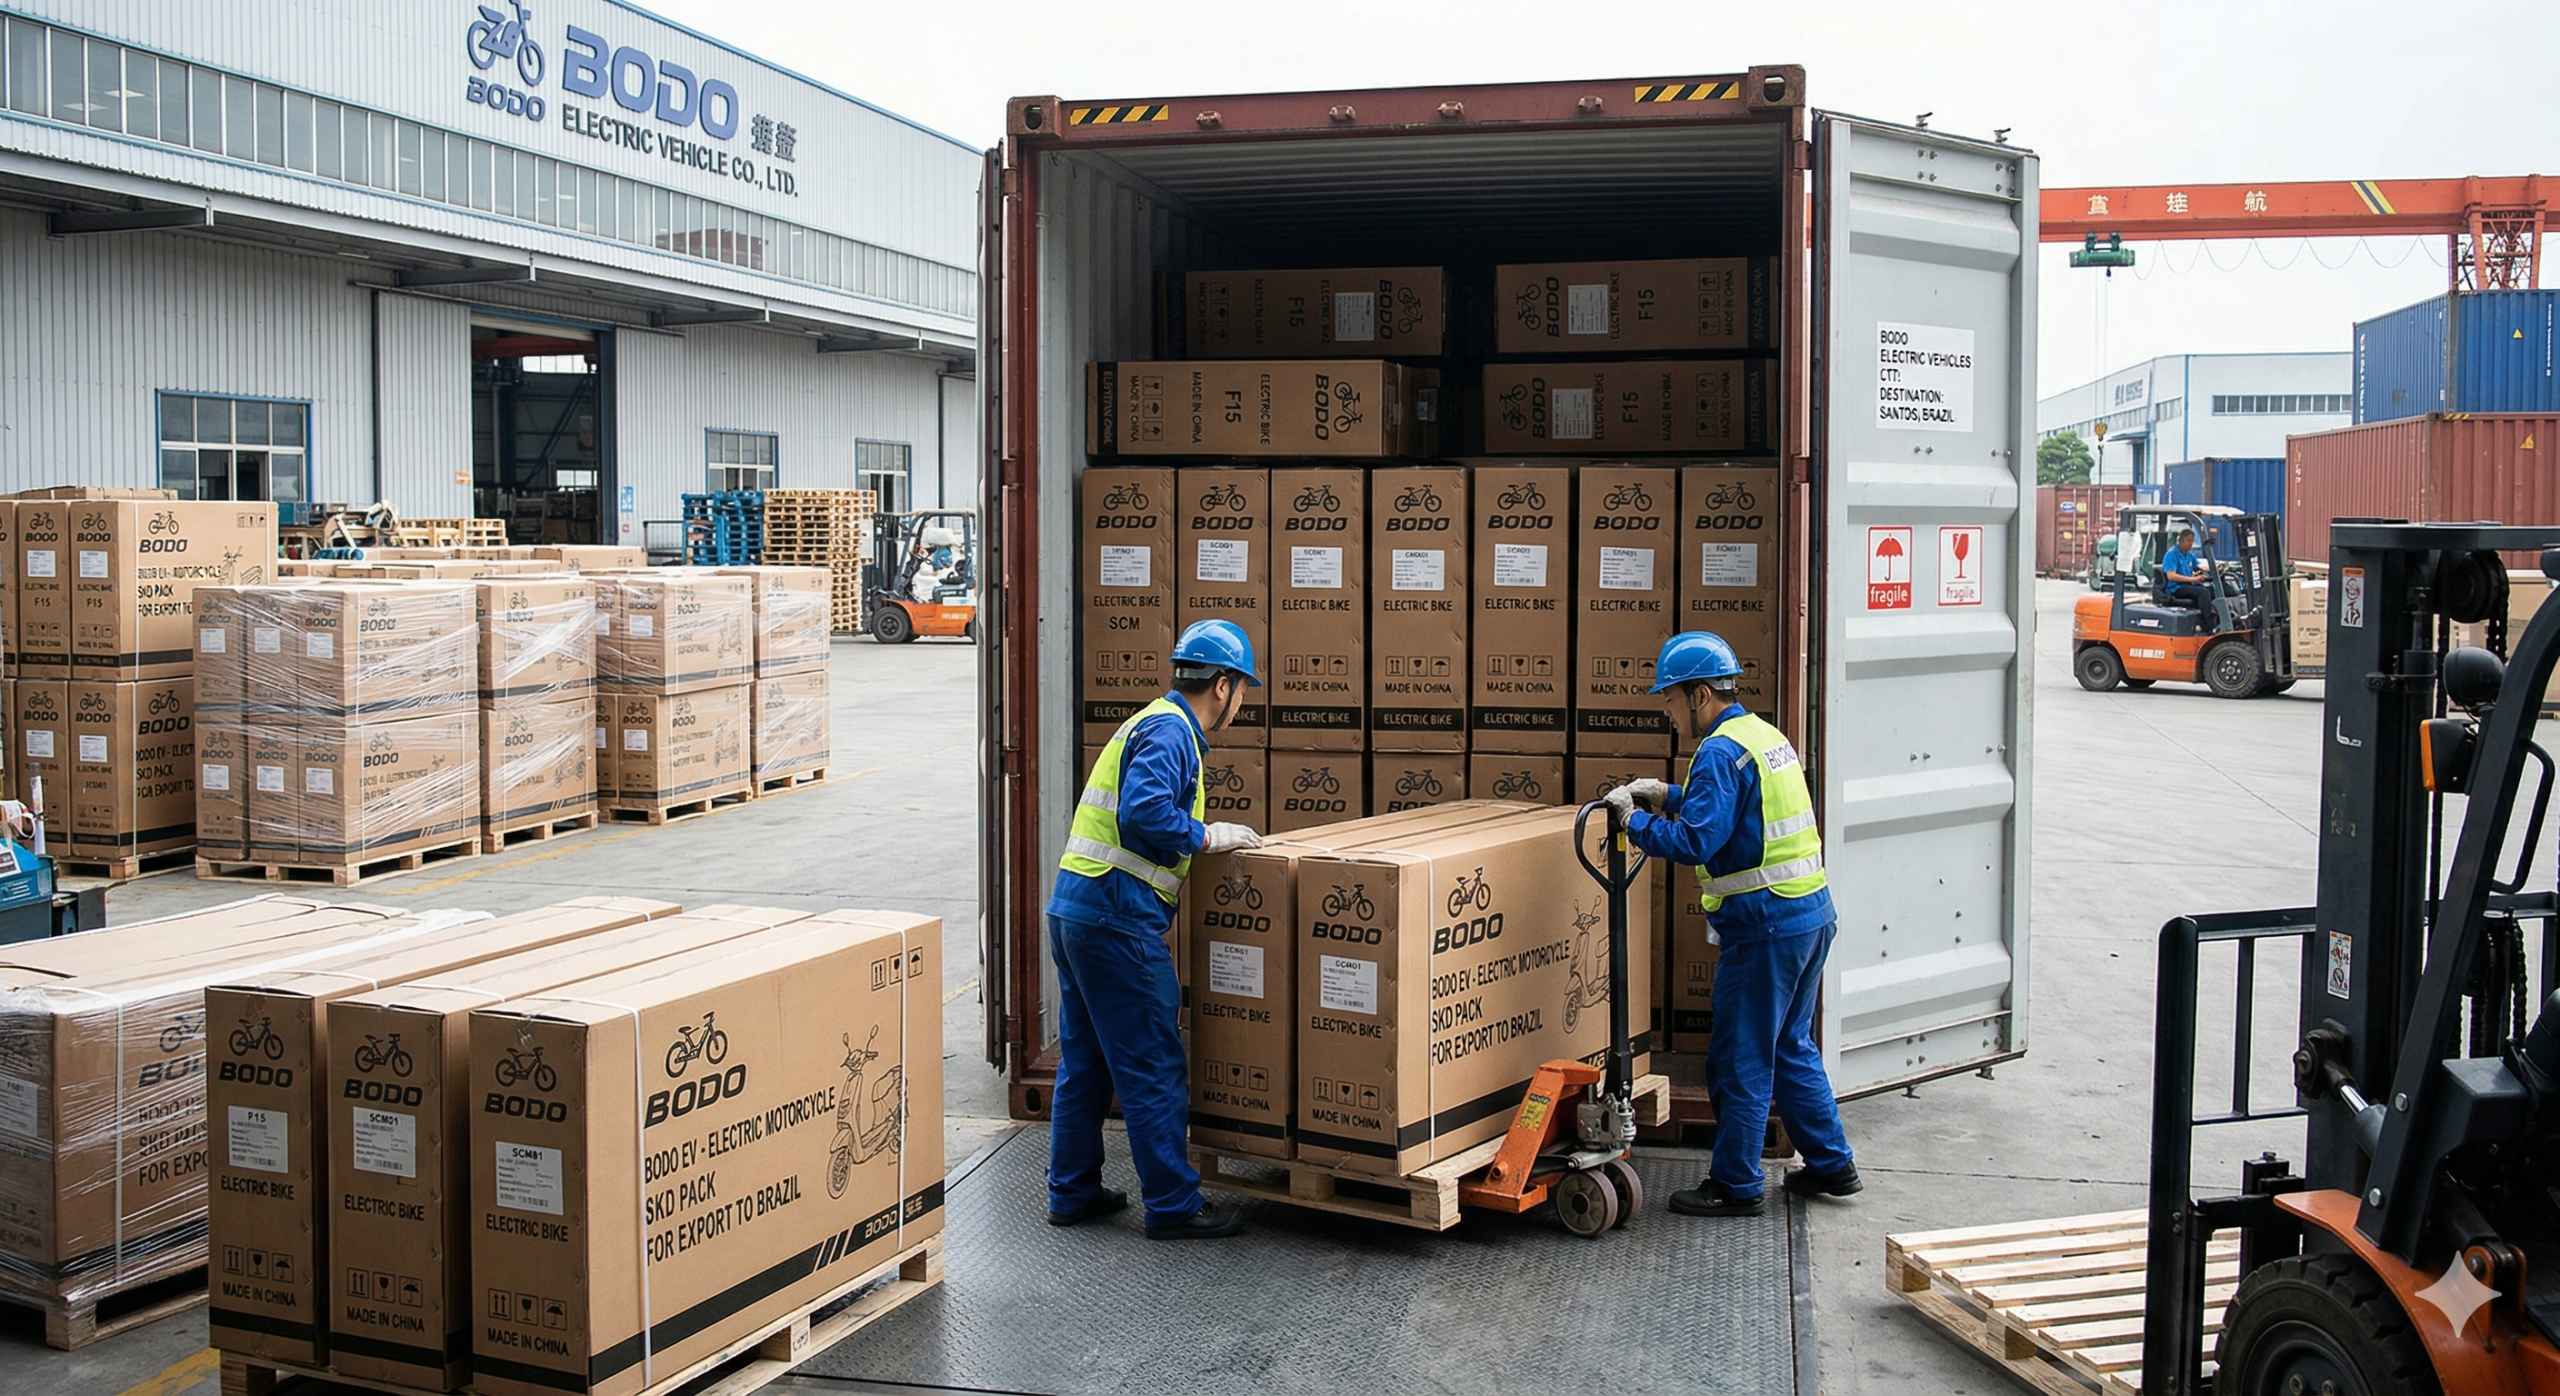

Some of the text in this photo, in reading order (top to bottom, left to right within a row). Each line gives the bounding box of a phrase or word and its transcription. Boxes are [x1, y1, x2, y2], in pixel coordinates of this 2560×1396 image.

[562, 24, 739, 141] BODO
[466, 75, 546, 122] BODO
[562, 103, 653, 154] ELECTRIC
[657, 132, 728, 176] VEHICLE
[731, 155, 763, 190] CO.,
[766, 166, 799, 197] LTD.
[1289, 296, 1305, 328] F15
[1379, 279, 1393, 340] BODO
[1546, 276, 1560, 338] BODO
[1638, 288, 1655, 320] F15
[1880, 329, 1909, 346] BODO
[1880, 349, 1972, 369] ELECTRIC VEHICLES
[1880, 386, 1944, 404] DESTINATION:
[1224, 390, 1242, 424] F15
[1260, 373, 1271, 446] ELECTRIC BIKE
[1315, 373, 1330, 441] BODO
[1532, 377, 1547, 439] BODO
[1622, 390, 1639, 424] F15
[1880, 405, 1921, 423] SANTOS,
[1095, 516, 1158, 529] BODO
[1191, 516, 1254, 530] BODO
[1285, 517, 1348, 531] BODO
[1386, 518, 1450, 532] BODO
[1487, 515, 1554, 530] BODO
[1593, 516, 1661, 531] BODO
[1694, 515, 1764, 530] BODO
[139, 539, 188, 553] BODO
[1093, 596, 1160, 607] ELECTRIC BIKE
[1189, 597, 1234, 608] ELECTRIC
[1870, 586, 1909, 607] fragile
[1946, 585, 1975, 602] fragile
[1328, 600, 1351, 611] BIKE
[1383, 599, 1429, 612] ELECTRIC
[1485, 598, 1531, 610] ELECTRIC
[1590, 600, 1661, 612] ELECTRIC BIKE
[1692, 600, 1764, 612] ELECTRIC BIKE
[1109, 616, 1140, 630] SCM
[1095, 677, 1121, 687] MADE
[1122, 677, 1130, 687] IN
[1283, 681, 1309, 692] MADE
[1385, 683, 1411, 693] MADE
[1486, 681, 1512, 693] MADE
[1590, 684, 1616, 695] MADE
[24, 711, 59, 722] BODO
[75, 712, 112, 723] BODO
[138, 716, 190, 736] BODO
[1282, 711, 1350, 724] ELECTRIC BIKE
[1383, 713, 1452, 725] ELECTRIC BIKE
[1484, 713, 1554, 725] ELECTRIC BIKE
[1589, 715, 1635, 727] ELECTRIC
[363, 752, 399, 768] BODO
[1205, 796, 1252, 811] ODO
[1284, 798, 1347, 813] BODO
[1203, 910, 1272, 933] BODO
[1311, 921, 1382, 946] BODO
[1432, 912, 1504, 956] BODO
[1459, 969, 1472, 995] EV
[1477, 955, 1517, 987] ELECTRIC
[1202, 1003, 1271, 1024] ELECTRIC BIKE
[1432, 996, 1483, 1034] SKD PACK
[1311, 1016, 1382, 1040] ELECTRIC BIKE
[1432, 1008, 1543, 1067] FOR EXPORT TO BRAZIL
[218, 1061, 294, 1089] BODO
[343, 1078, 423, 1108] BODO
[643, 1063, 747, 1131] BODO
[1203, 1090, 1229, 1105] MADE
[1230, 1094, 1240, 1106] IN
[484, 1092, 568, 1124] BODO
[1312, 1109, 1382, 1131] MADE IN CHINA
[645, 1146, 679, 1185] BODO
[682, 1138, 698, 1170] EV
[708, 1114, 763, 1159] ELECTRIC
[765, 1086, 836, 1138] MOTORCYCLE
[138, 1160, 170, 1187] FOR
[221, 1175, 295, 1201] ELECTRIC BIKE
[344, 1194, 425, 1222] ELECTRIC BIKE
[646, 1170, 717, 1227] SKD PACK
[486, 1213, 569, 1243] ELECTRIC BIKE
[646, 1174, 802, 1268] FOR EXPORT TO BRAZIL
[222, 1281, 297, 1308] MADE IN CHINA
[346, 1305, 425, 1333] MADE IN CHINA
[487, 1327, 570, 1357] MADE IN CHINA
